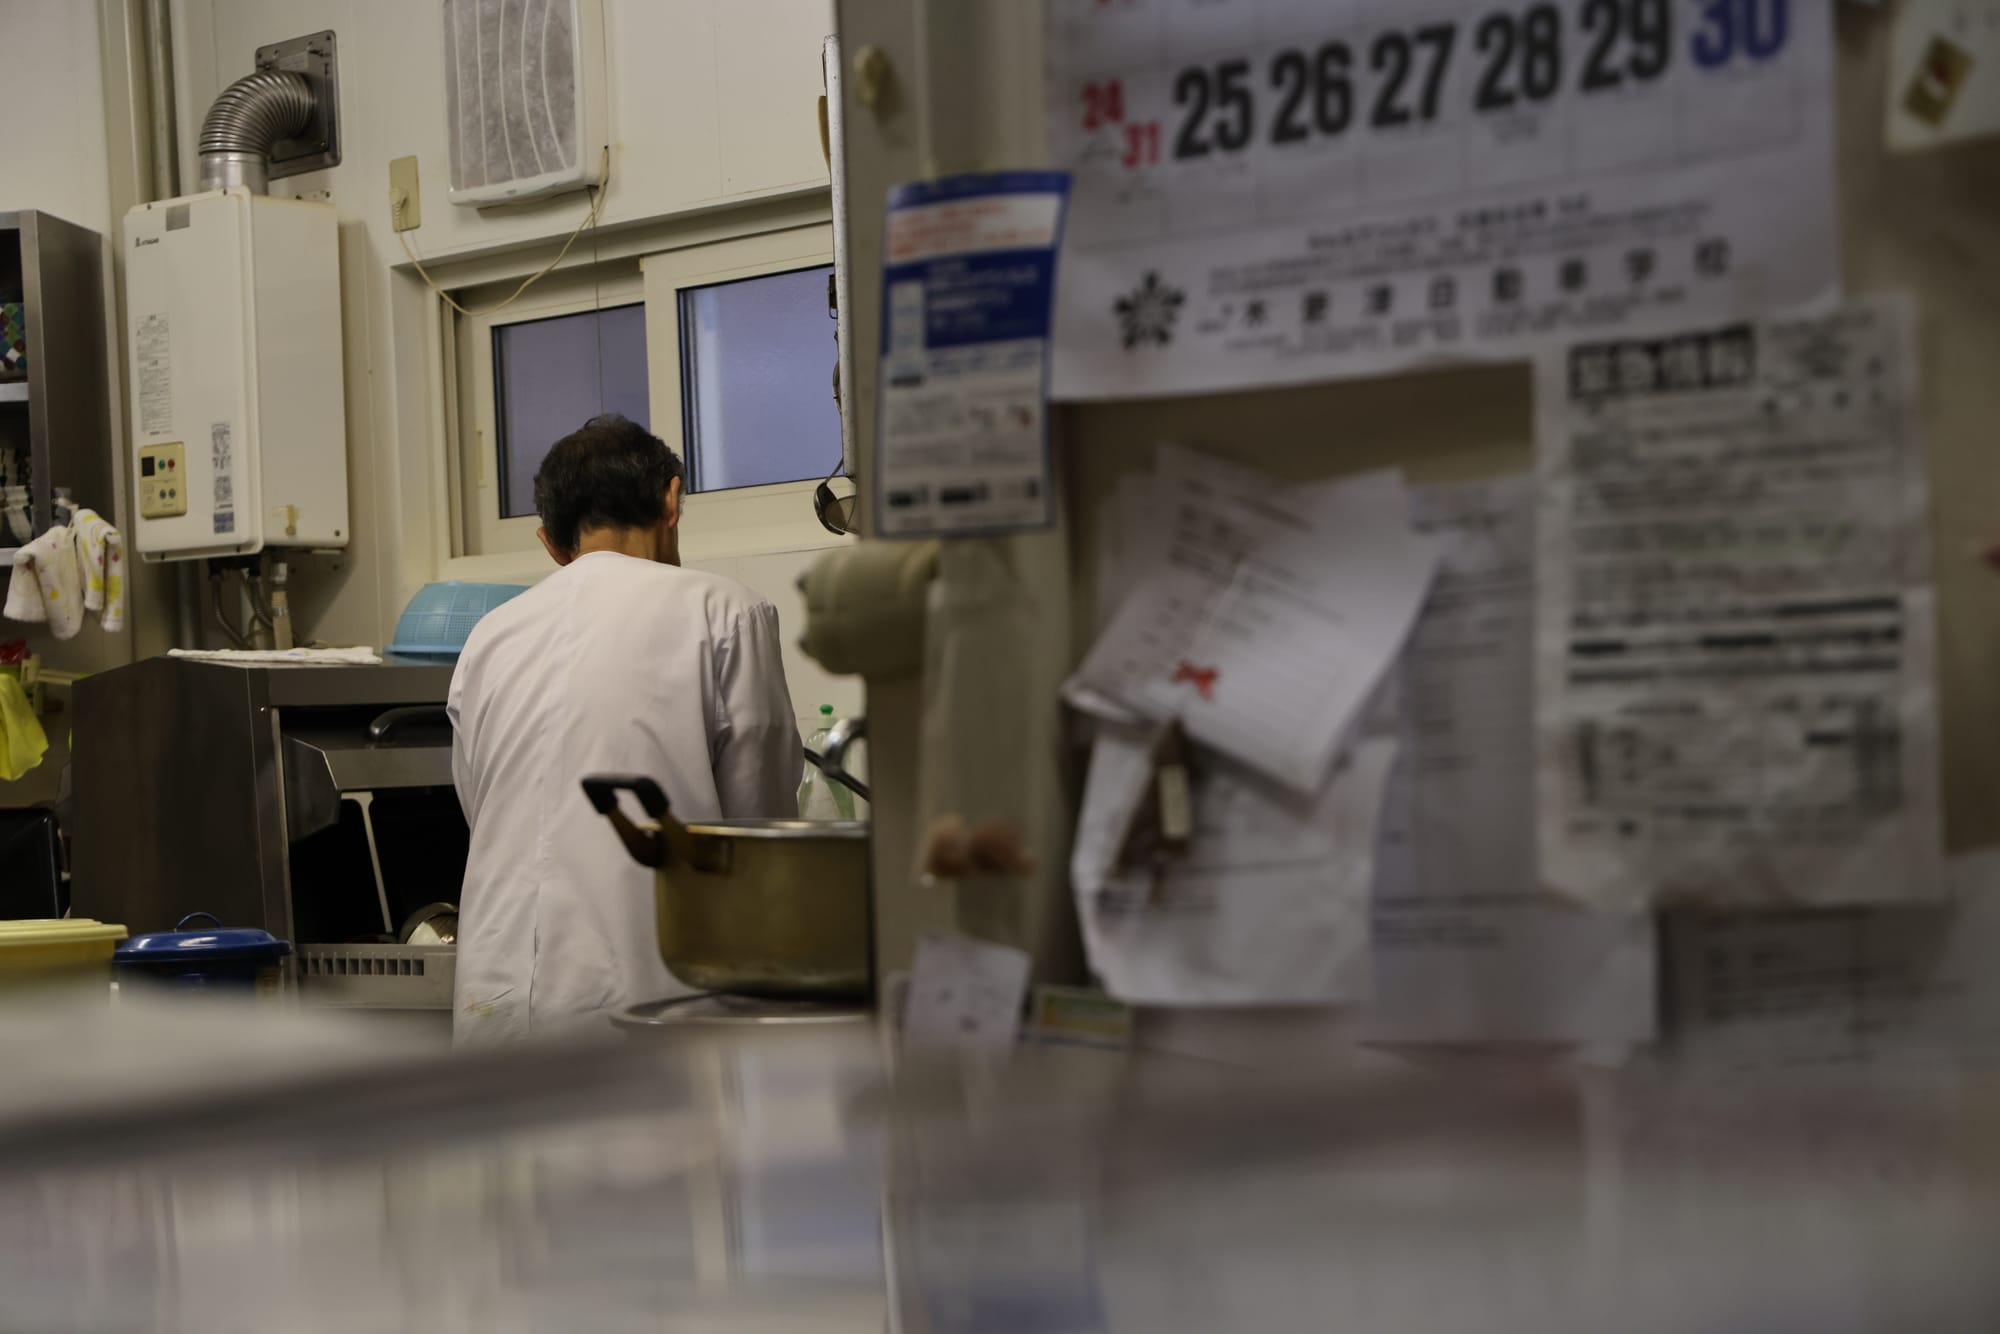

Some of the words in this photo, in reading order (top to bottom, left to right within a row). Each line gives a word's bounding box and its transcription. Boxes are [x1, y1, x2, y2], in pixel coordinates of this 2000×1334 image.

[1081, 78, 1124, 132] 24
[1173, 60, 1254, 161] 25
[1269, 42, 1353, 146] 26
[1369, 22, 1457, 129] 27
[1474, 4, 1561, 112] 28
[1578, 0, 1671, 92] 29
[1690, 0, 1790, 69] 30
[1121, 120, 1161, 170] 31
